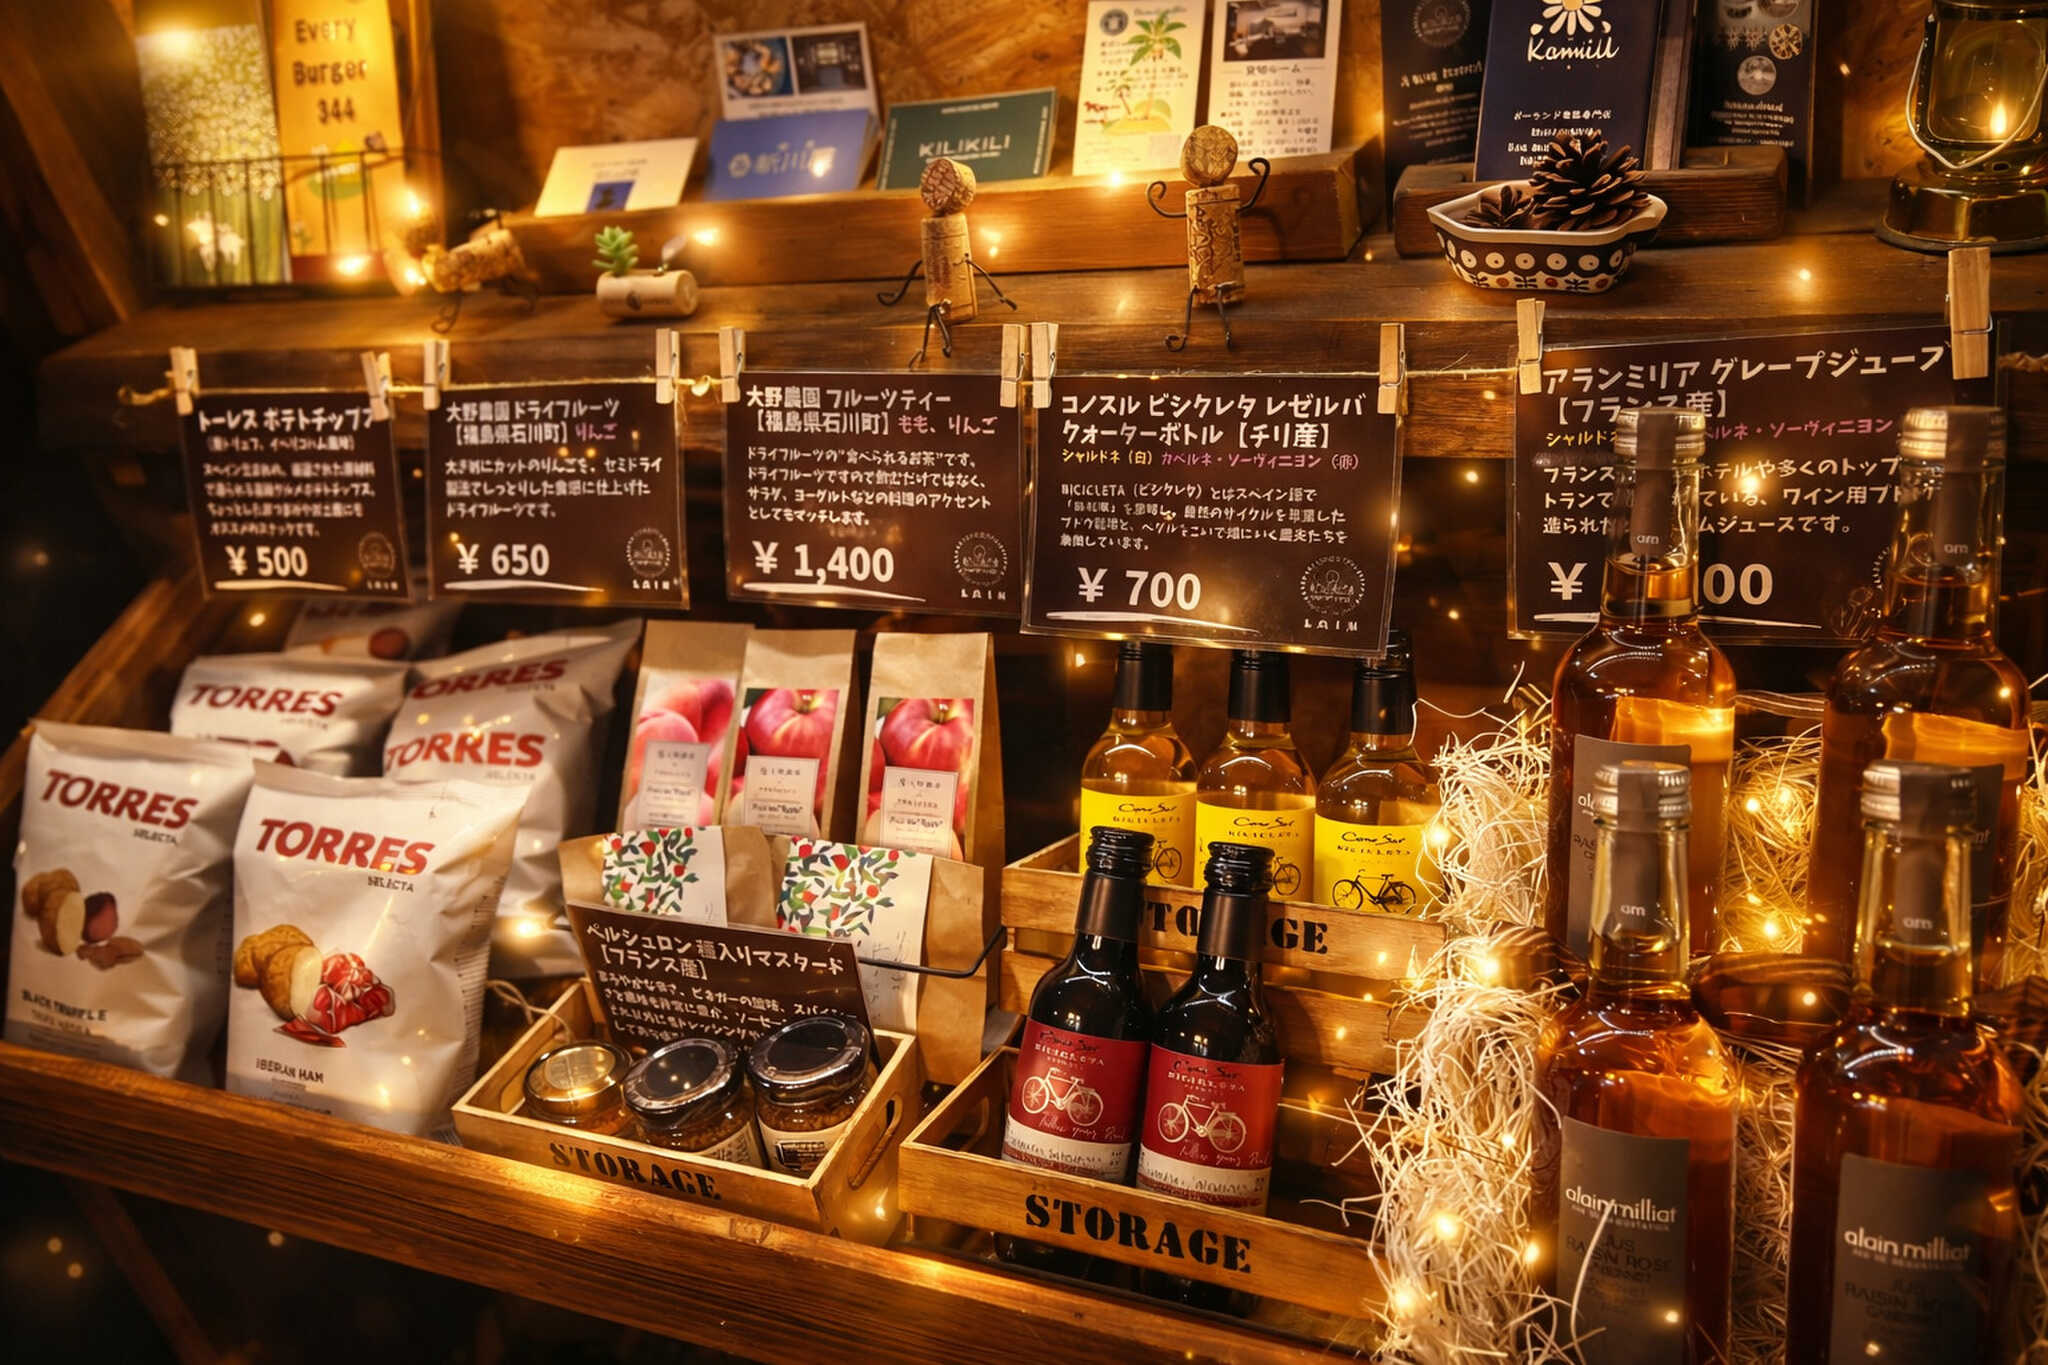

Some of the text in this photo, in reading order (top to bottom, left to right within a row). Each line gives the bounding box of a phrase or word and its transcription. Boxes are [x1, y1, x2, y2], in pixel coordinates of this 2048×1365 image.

[295, 19, 356, 43] Every
[293, 61, 367, 86] Burger
[918, 135, 1011, 158] KILIKILI
[1542, 361, 1700, 396] アランミリア
[515, 397, 620, 420] ドライフルーツ
[746, 385, 951, 411] 大野農園 フルーツティー
[1061, 392, 1368, 418] コノスル ビシクレタ レゼルバ
[199, 408, 258, 432] トーレス
[1061, 419, 1224, 446] クォーターボトル
[256, 545, 309, 577] 500
[456, 543, 550, 576] ¥ 650
[752, 541, 895, 586] ¥ 1,400
[1078, 567, 1201, 611] ¥ 700
[1548, 561, 1774, 605] ¥ 00
[189, 683, 343, 718] TORRES
[386, 732, 547, 772] TORRES
[39, 768, 199, 830] TORRES
[256, 818, 436, 876] TORRES
[1620, 904, 1647, 917] am
[1903, 917, 1934, 930] am
[299, 1068, 324, 1084] HAM
[549, 1141, 723, 1201] STORAGE
[1025, 1194, 1252, 1273] STORAGE
[1843, 1226, 1900, 1256] alain
[1902, 1235, 1972, 1262] milliat
